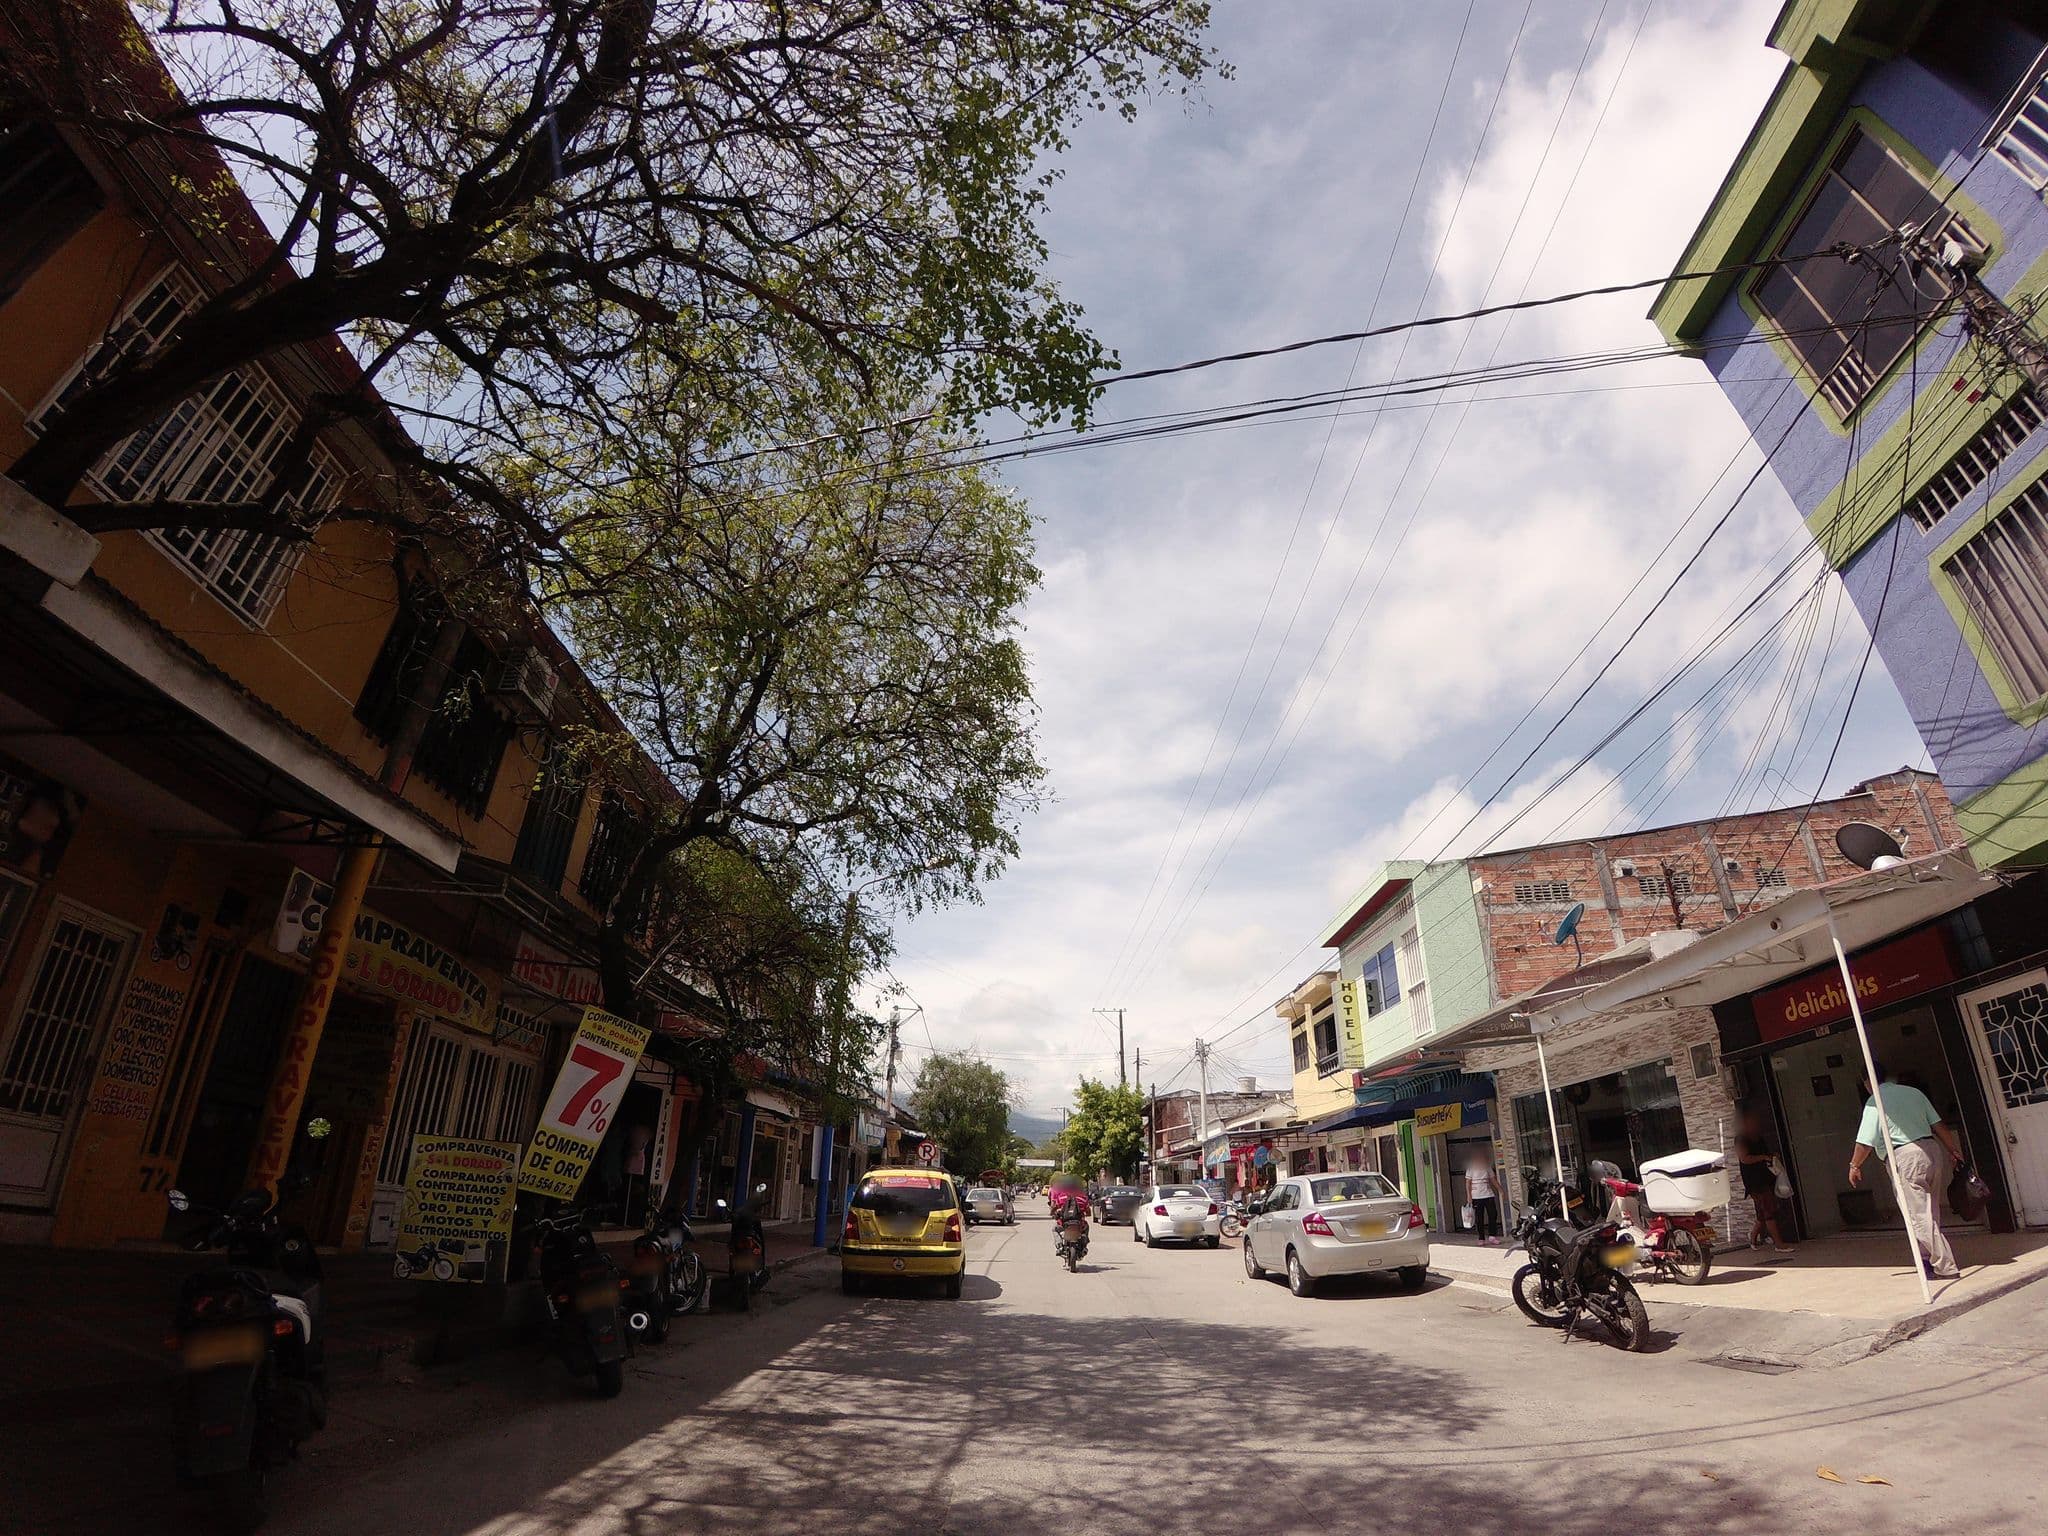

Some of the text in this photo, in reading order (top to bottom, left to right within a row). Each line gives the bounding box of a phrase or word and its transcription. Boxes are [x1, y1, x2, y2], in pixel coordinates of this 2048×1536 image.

[378, 960, 464, 1014] DORADO
[1785, 974, 1880, 1023] delichiks
[1341, 982, 1356, 1041] HOTEL
[586, 1011, 647, 1045] COMPRAVENTA
[608, 1030, 640, 1047] DORADO
[579, 1028, 619, 1053] CONTRATE
[120, 1048, 164, 1071] ELECTRO
[101, 1083, 150, 1106] CELULAR
[416, 1141, 515, 1164] COMPRAVENTA
[534, 1130, 595, 1162] COMPRA
[453, 1156, 502, 1169] DORADO
[529, 1151, 553, 1171] DE
[422, 1168, 503, 1184] COMPRAMOS
[518, 1171, 537, 1186] 313
[536, 1177, 554, 1190] 554
[553, 1181, 567, 1193] 67
[416, 1179, 506, 1196] CONTRATAMOS
[420, 1190, 500, 1206] Y VENDEMOS
[418, 1202, 498, 1218] ORO, PLATA,
[421, 1214, 491, 1228] MOTOS Y
[403, 1224, 508, 1241] ELECTRODOMESTICOS
